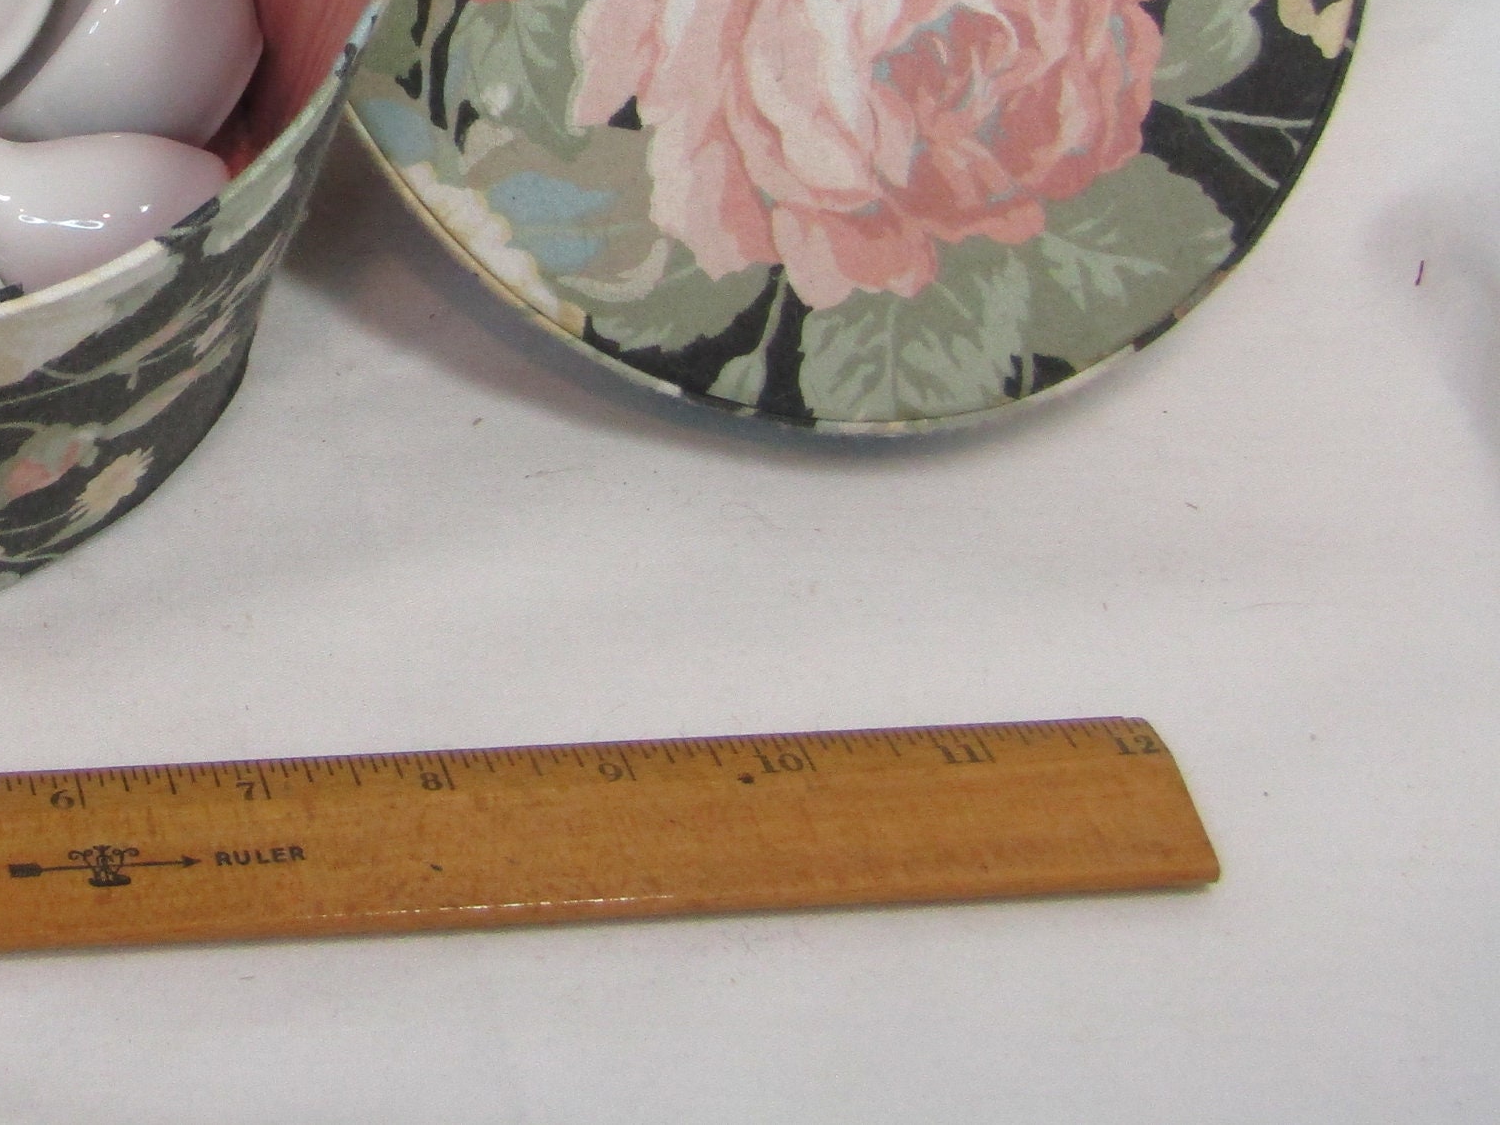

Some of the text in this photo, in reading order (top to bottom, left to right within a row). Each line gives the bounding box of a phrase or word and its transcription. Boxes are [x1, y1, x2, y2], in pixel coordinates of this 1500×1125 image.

[50, 789, 75, 809] 6
[235, 781, 255, 801] 7
[420, 771, 444, 791] 8
[598, 762, 623, 782] 9
[753, 753, 804, 774] 10
[936, 743, 984, 764] 11
[1113, 735, 1161, 756] 12
[215, 845, 307, 867] RULER
